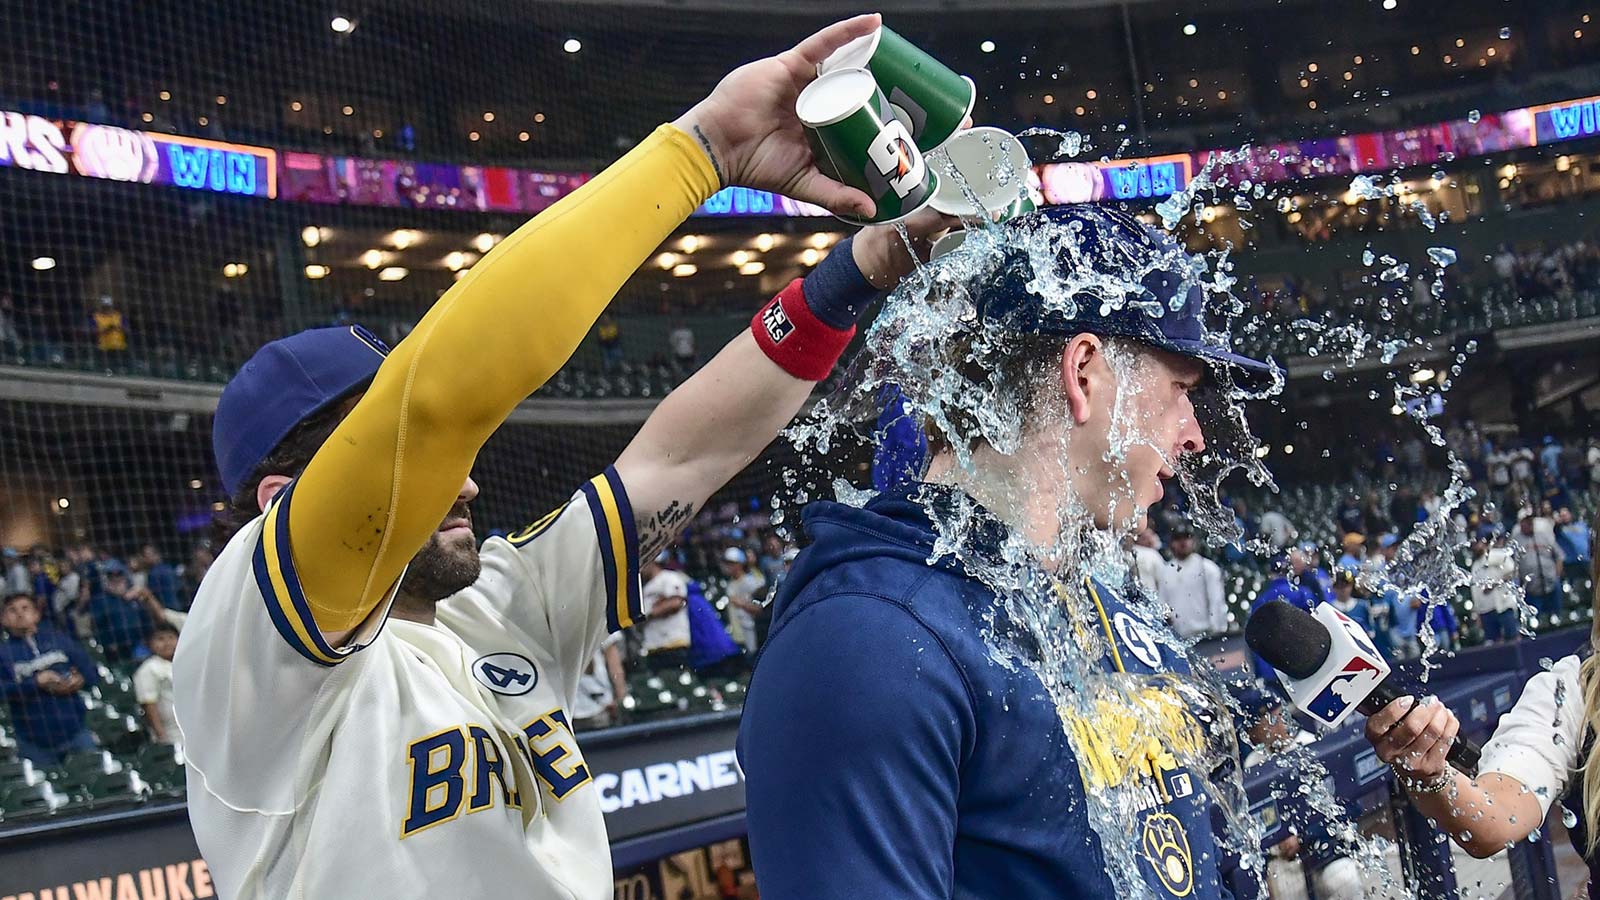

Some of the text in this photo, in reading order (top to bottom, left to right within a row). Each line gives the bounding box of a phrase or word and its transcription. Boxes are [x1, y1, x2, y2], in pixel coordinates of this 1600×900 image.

[1550, 100, 1600, 138] WI
[168, 144, 257, 195] WIN
[1108, 162, 1176, 199] WIN
[704, 186, 774, 214] WIN
[1122, 618, 1158, 662] 4
[480, 661, 531, 688] 4
[594, 750, 745, 813] CARNE
